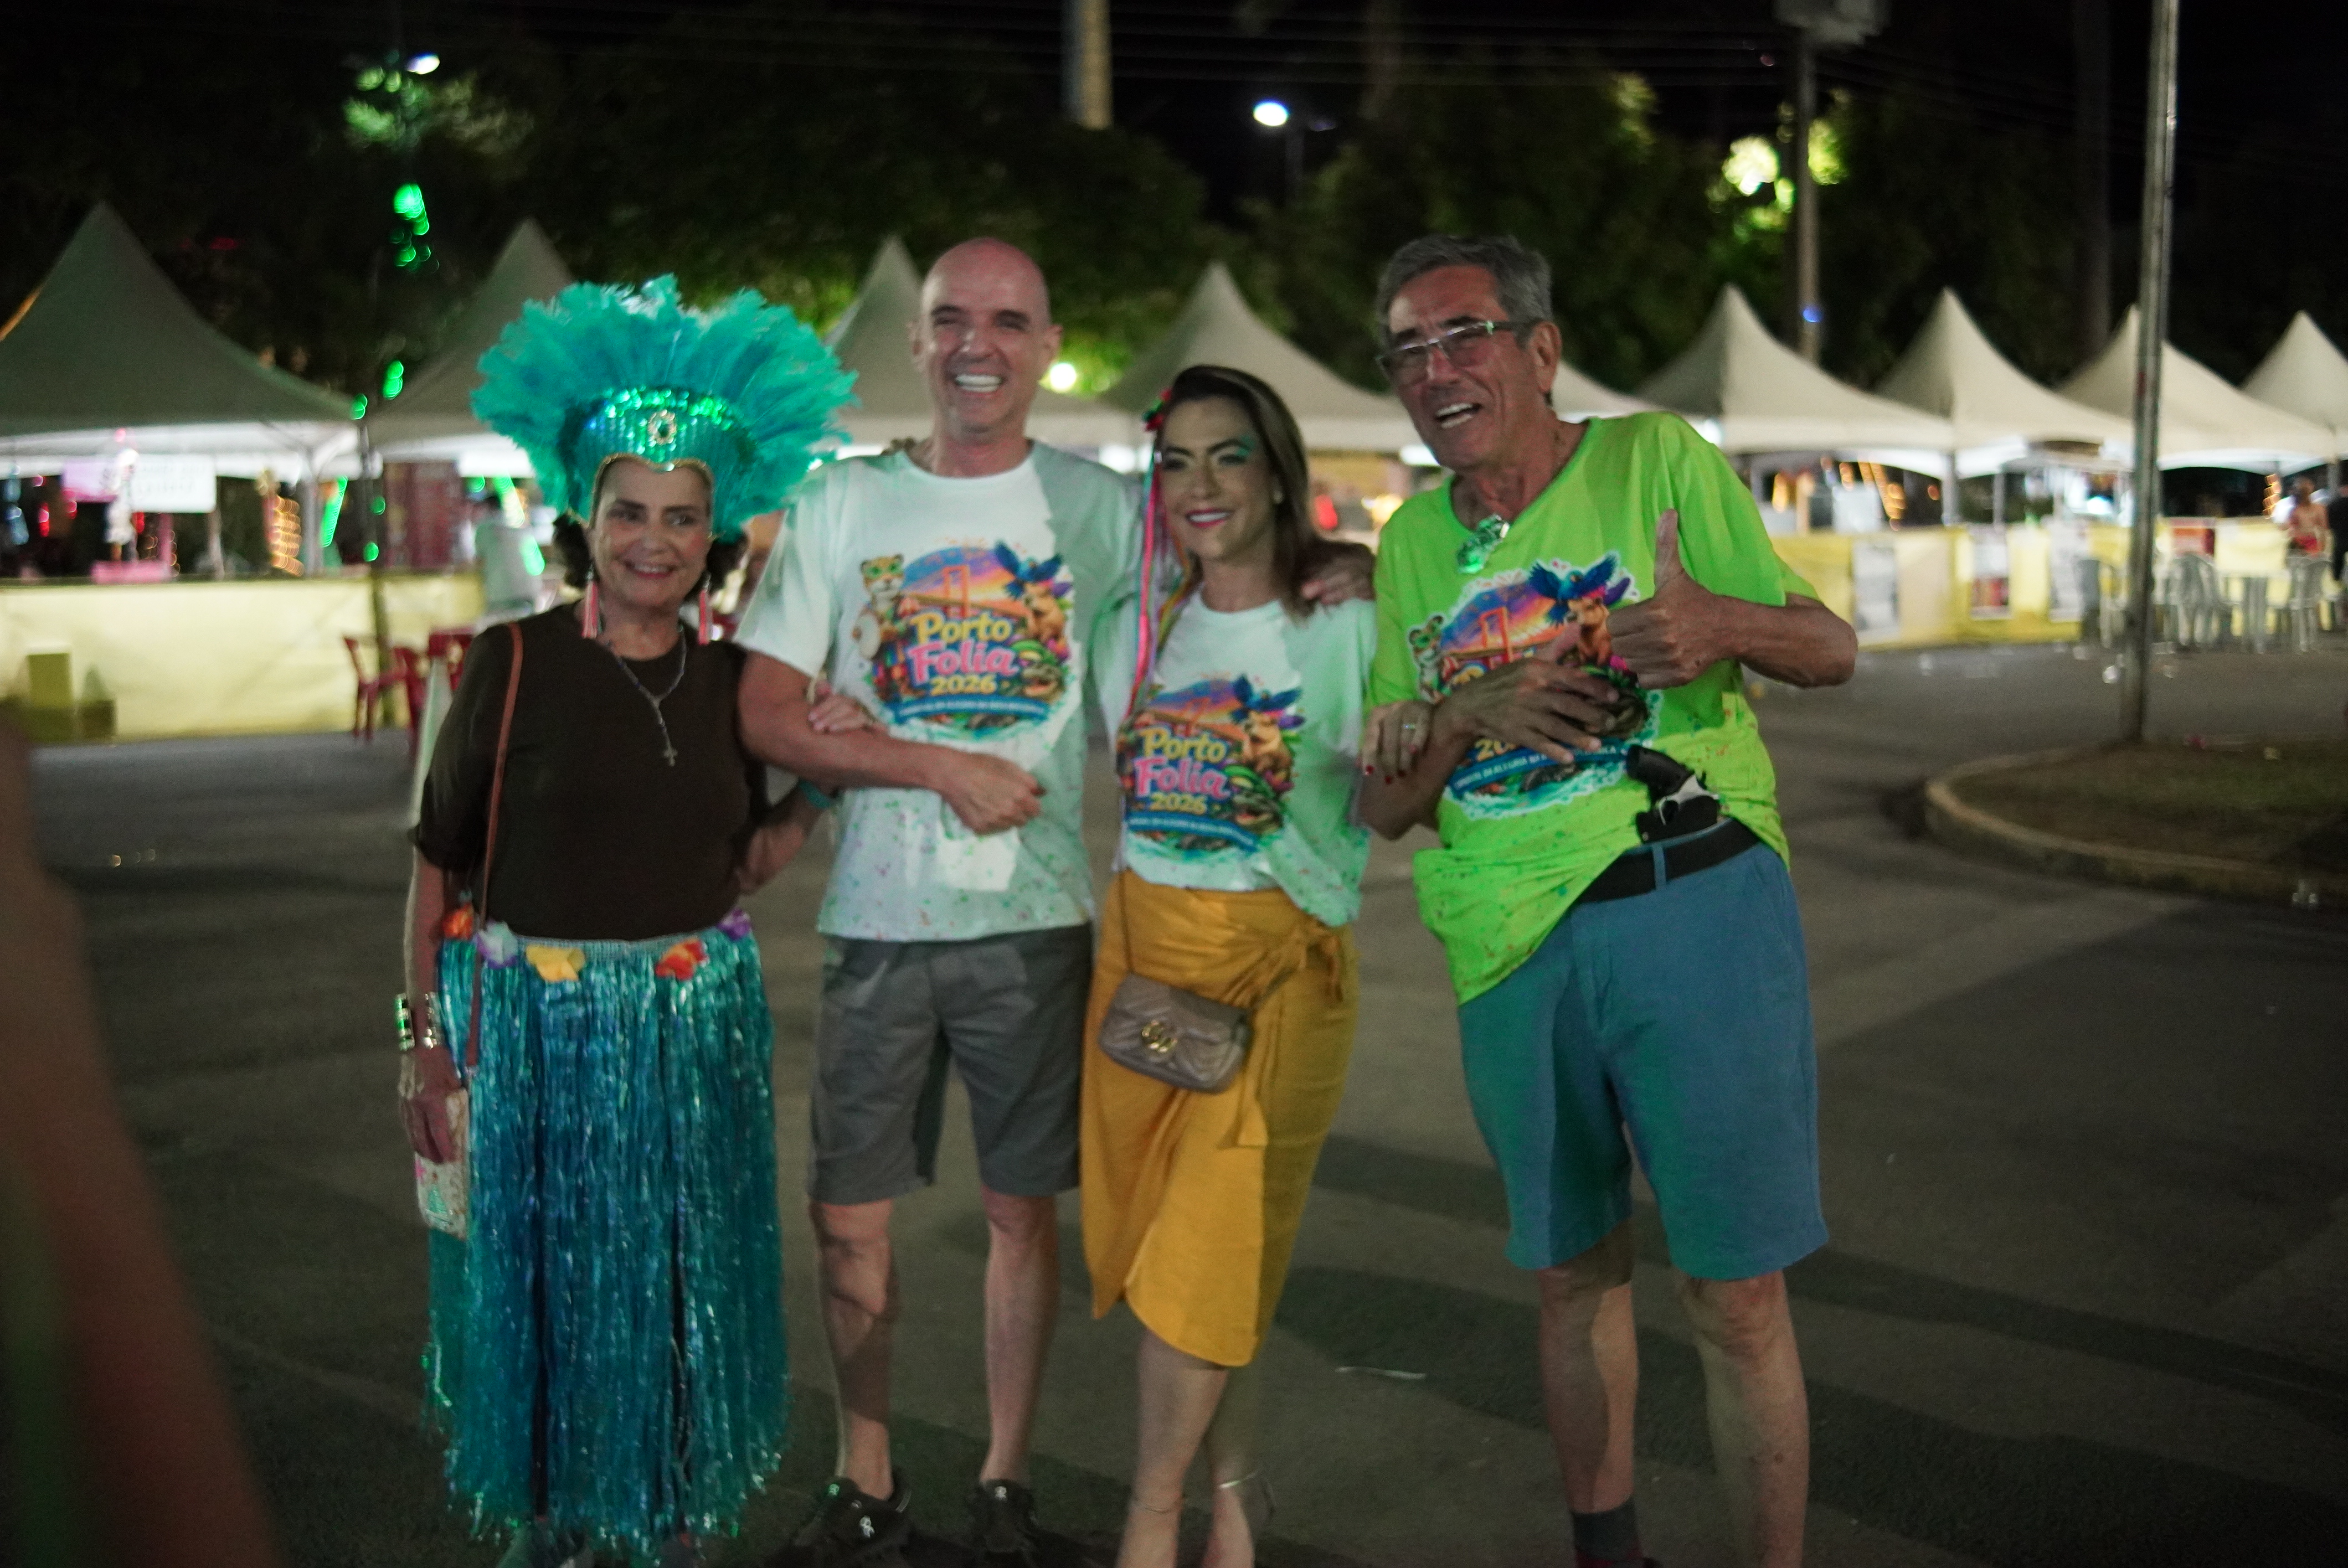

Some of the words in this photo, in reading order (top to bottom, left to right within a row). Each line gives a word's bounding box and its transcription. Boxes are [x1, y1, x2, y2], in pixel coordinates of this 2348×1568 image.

[909, 610, 1012, 644] Porto
[907, 639, 1019, 684] Folia
[931, 675, 996, 694] 2026
[1139, 726, 1226, 762] Porto
[1134, 757, 1233, 799] Folia
[1150, 792, 1207, 814] 2026
